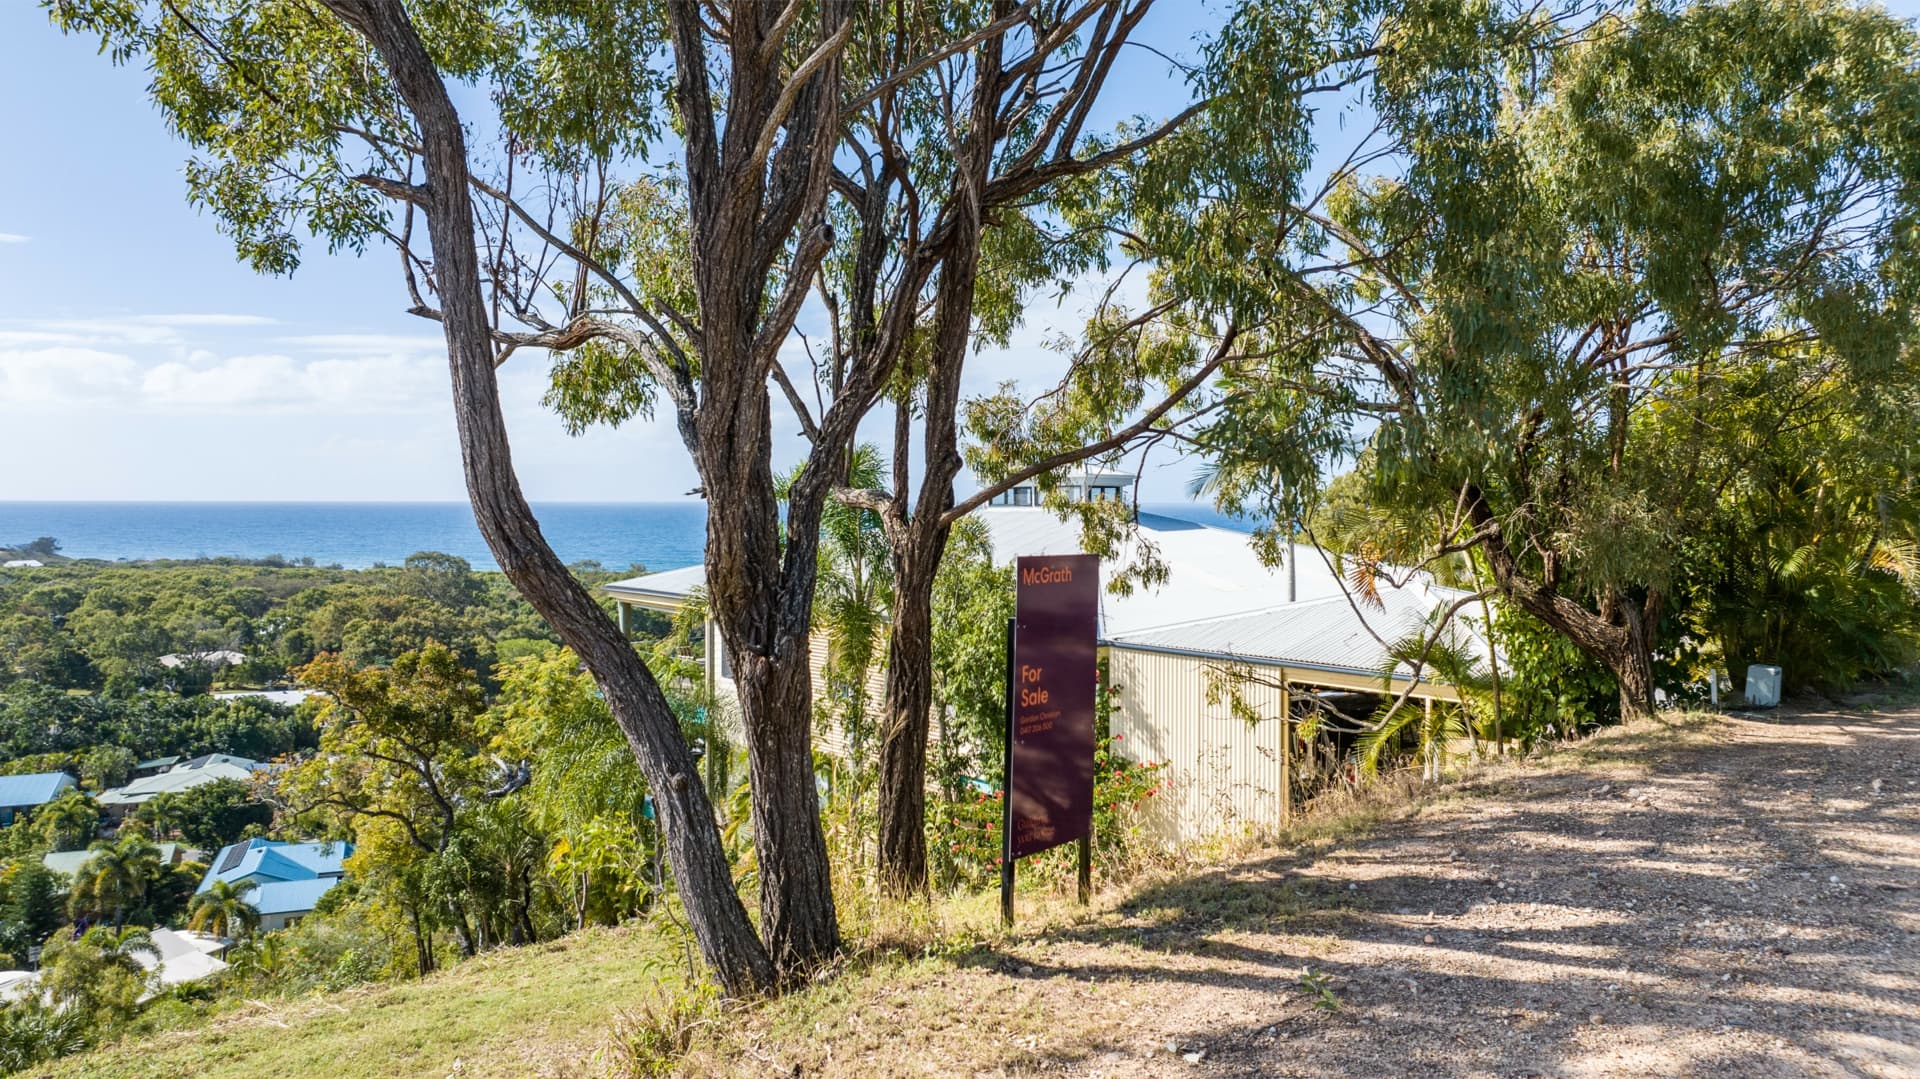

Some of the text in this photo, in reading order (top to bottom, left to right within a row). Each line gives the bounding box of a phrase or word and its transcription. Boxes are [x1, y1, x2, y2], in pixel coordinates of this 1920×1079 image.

[1023, 566, 1072, 585] McGrath
[1022, 665, 1043, 684] For
[1021, 685, 1049, 707] Sale
